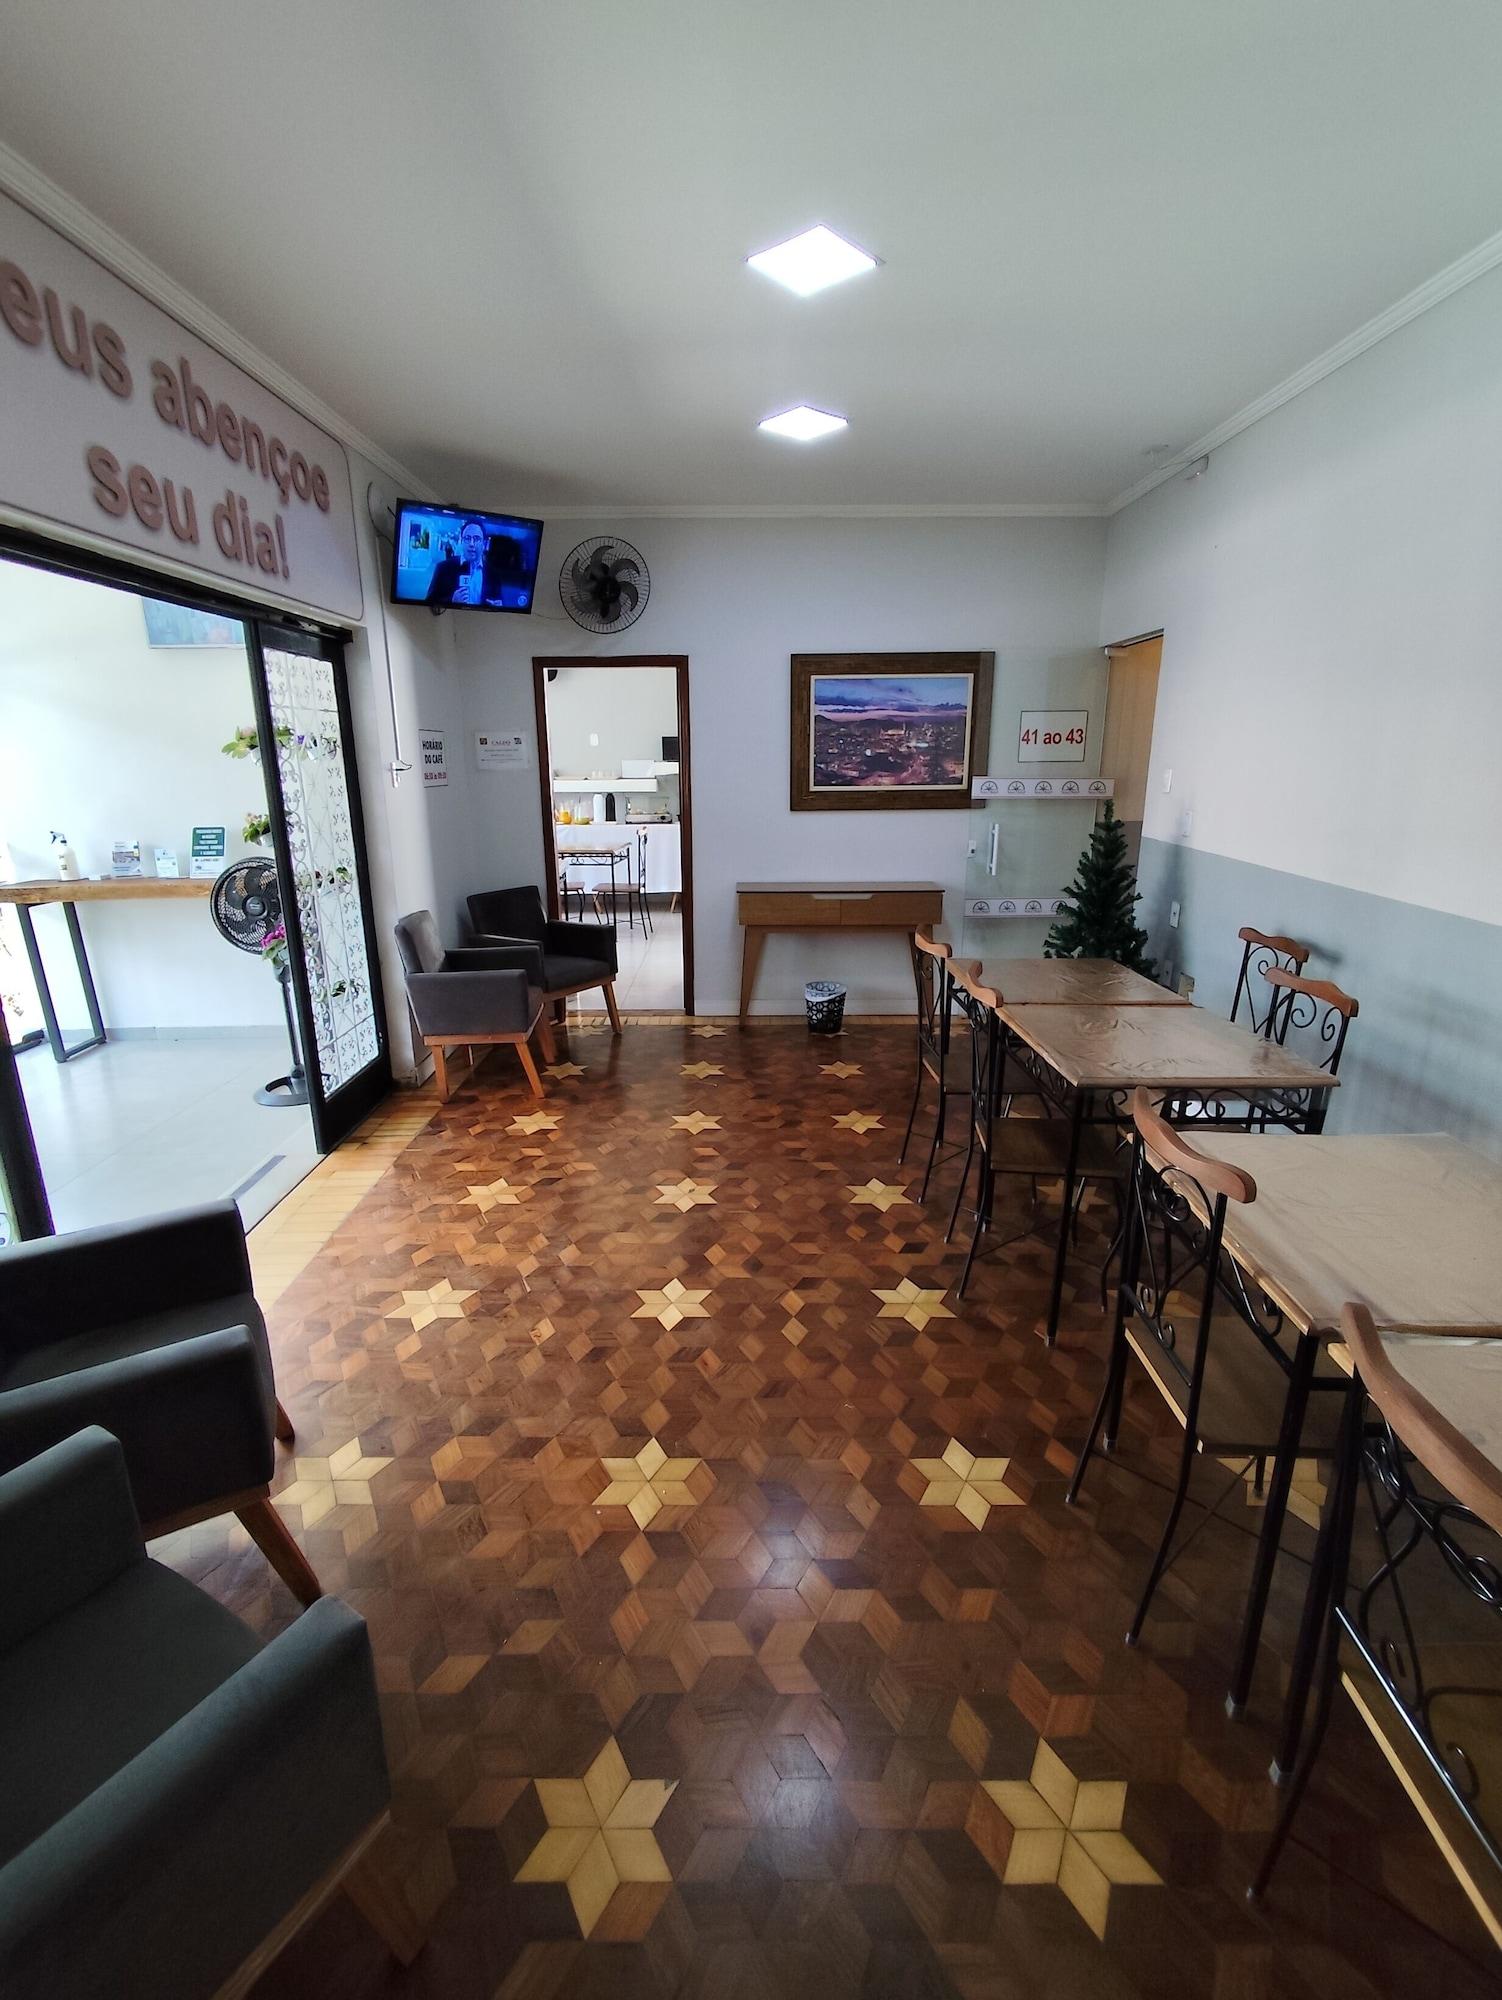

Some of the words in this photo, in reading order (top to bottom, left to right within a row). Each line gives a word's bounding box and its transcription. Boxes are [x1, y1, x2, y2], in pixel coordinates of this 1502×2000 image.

[151, 356, 330, 513] abençoe
[87, 445, 199, 545] seu
[213, 489, 290, 580] dia!
[1021, 729, 1038, 745] 41
[1043, 732, 1062, 745] ao
[1065, 728, 1084, 744] 43
